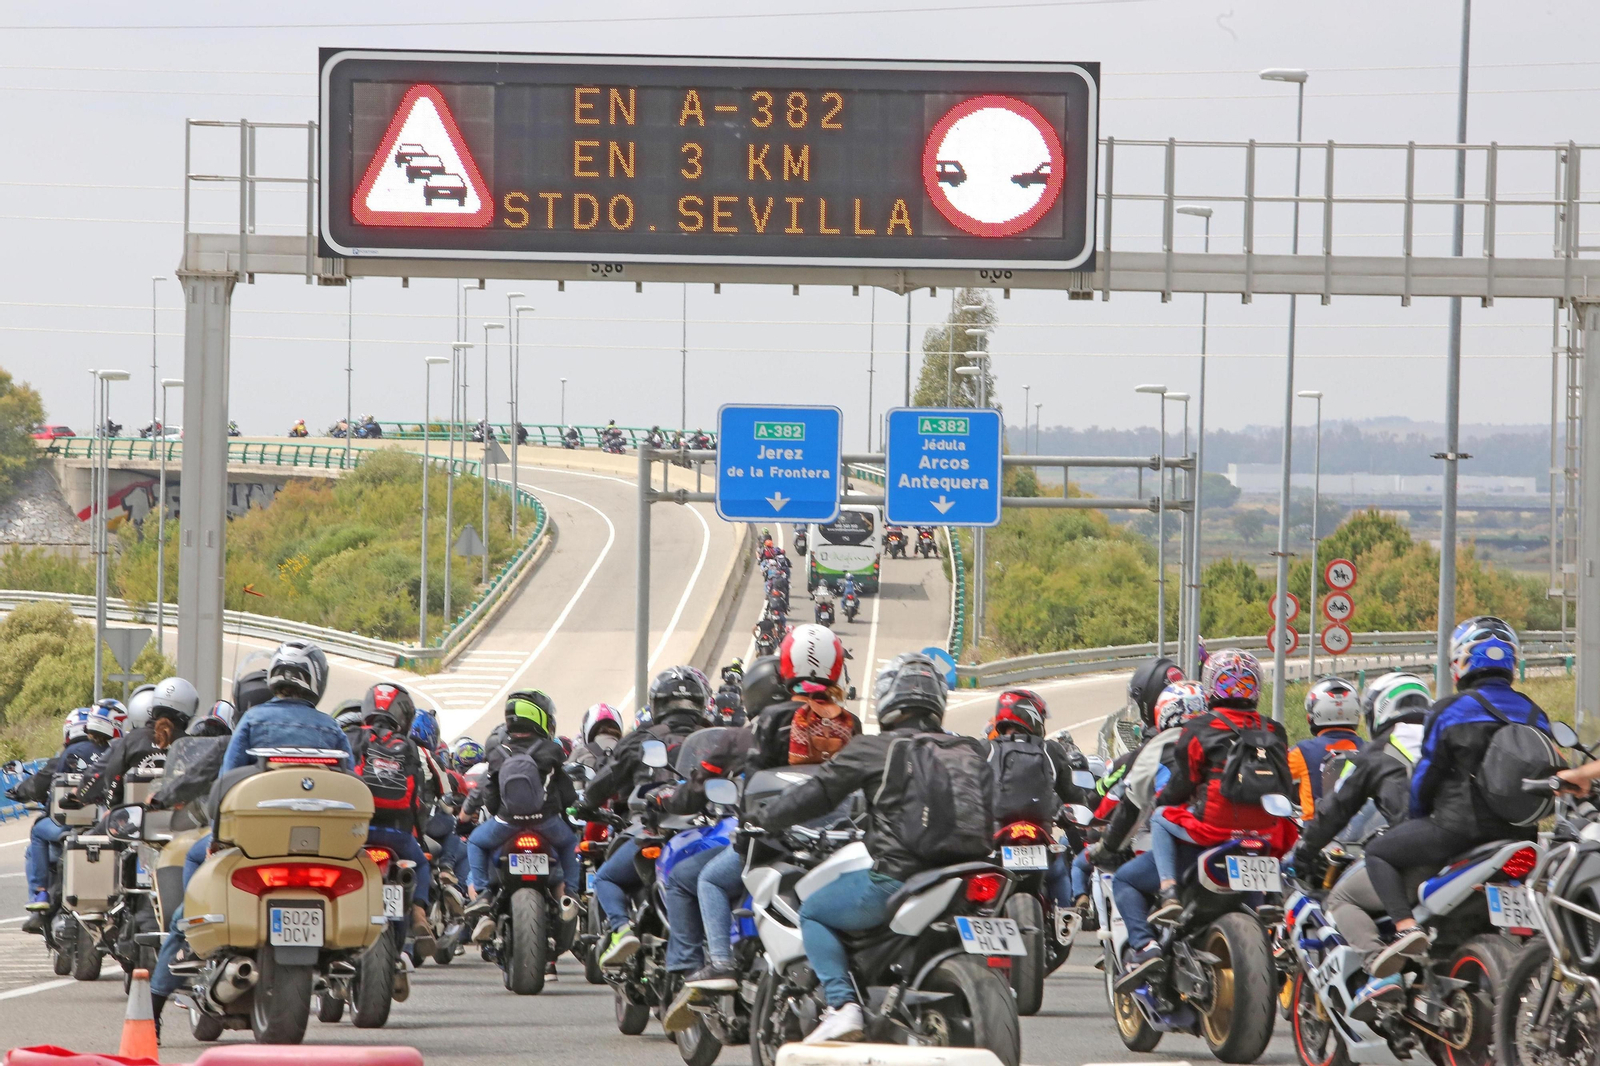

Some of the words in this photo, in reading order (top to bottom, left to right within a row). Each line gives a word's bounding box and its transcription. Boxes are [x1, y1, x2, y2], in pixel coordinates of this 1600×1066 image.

[574, 87, 636, 126] EN
[679, 89, 844, 129] A-382
[574, 140, 635, 178] EN
[681, 142, 703, 180] 3
[747, 143, 810, 182] KM
[503, 192, 656, 230] STDO.
[677, 195, 914, 236] SEVILLA
[758, 424, 802, 438] A-382
[922, 419, 966, 433] A-382
[922, 438, 966, 451] Jédula
[757, 445, 803, 460] Jerez
[919, 456, 970, 470] Arcos
[727, 466, 744, 478] de
[750, 466, 764, 478] la
[770, 467, 830, 479] Frontera
[898, 474, 989, 492] Antequera
[1240, 859, 1277, 874] 3402
[283, 911, 320, 926] 6026
[284, 928, 311, 942] DCV
[971, 920, 1017, 936] 6915
